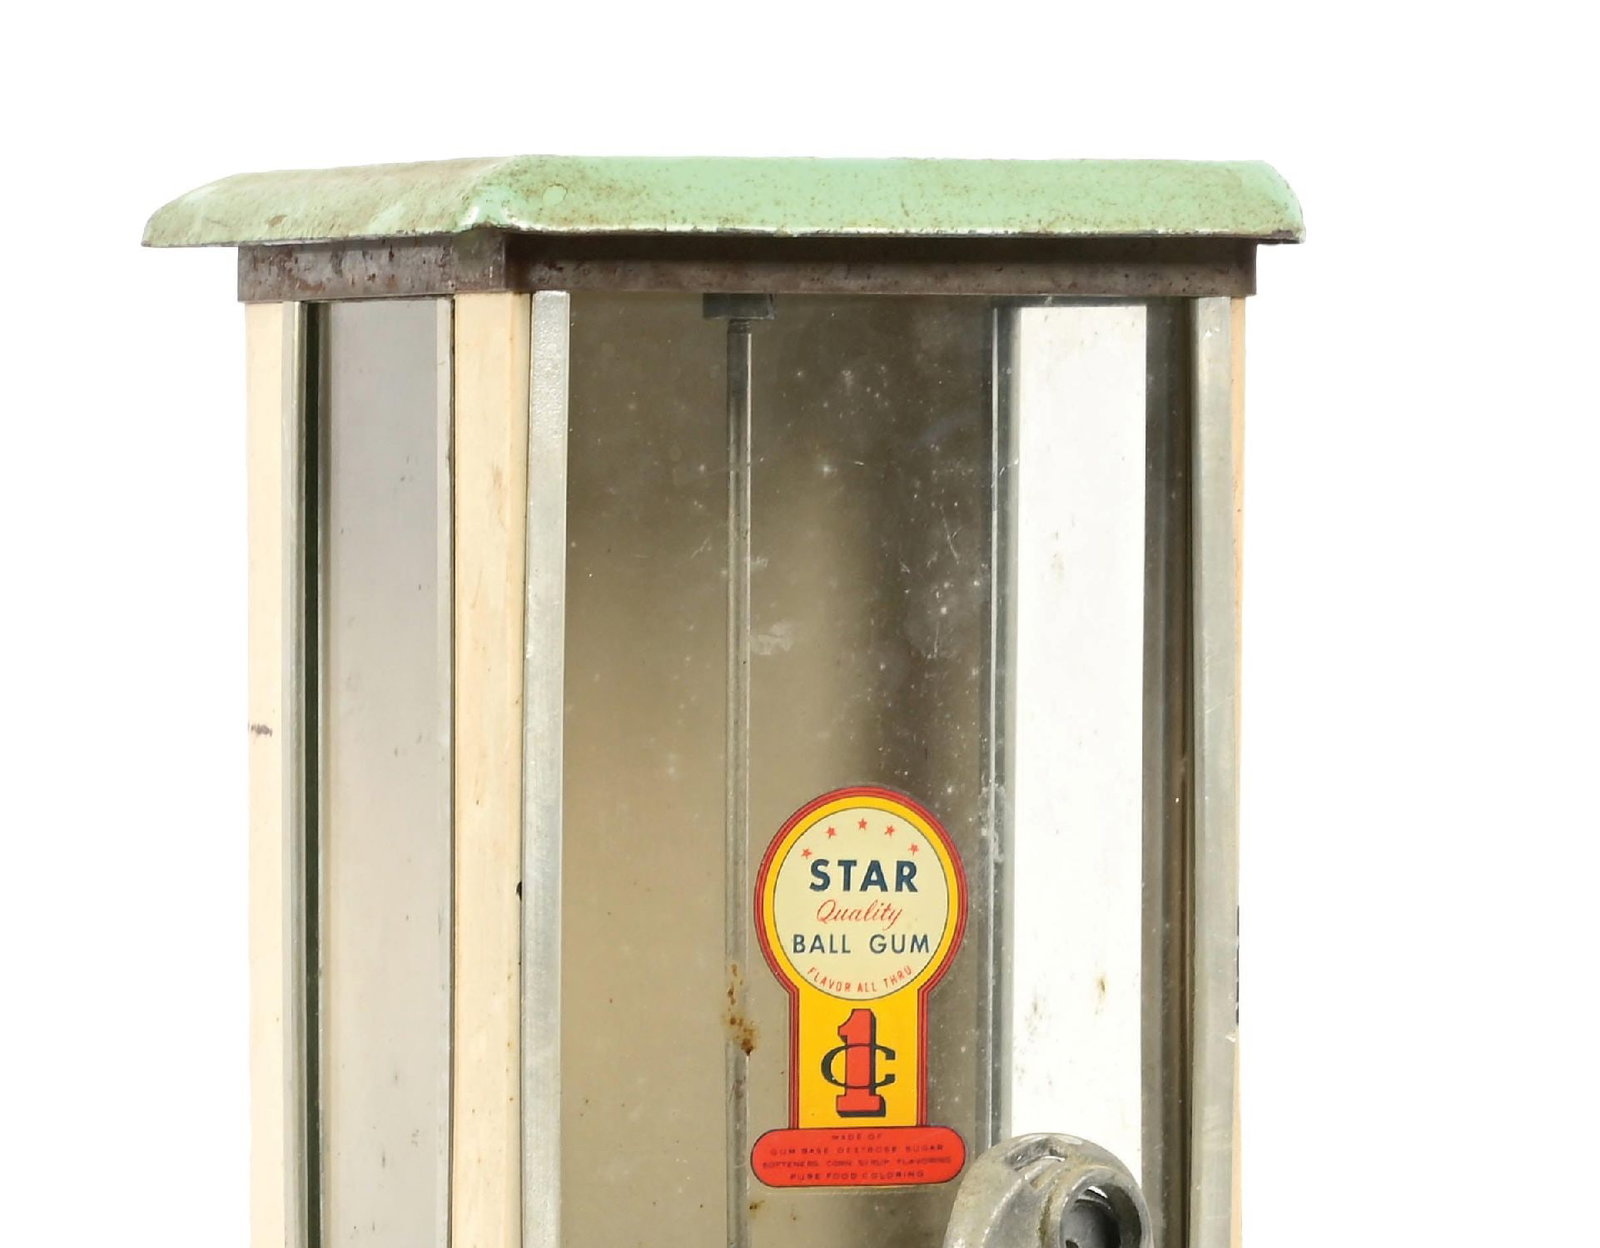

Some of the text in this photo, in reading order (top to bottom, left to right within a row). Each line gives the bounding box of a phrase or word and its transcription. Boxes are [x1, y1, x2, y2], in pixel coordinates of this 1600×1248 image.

[809, 858, 918, 893] STAR
[815, 899, 904, 931] Quality
[792, 933, 930, 955] BALL GUM
[807, 966, 913, 993] FLAVOR ALL THRU
[831, 1133, 862, 1141] MADE
[769, 1147, 796, 1156] GUM
[789, 1172, 821, 1181] PURE
[826, 1171, 857, 1180] FOOD
